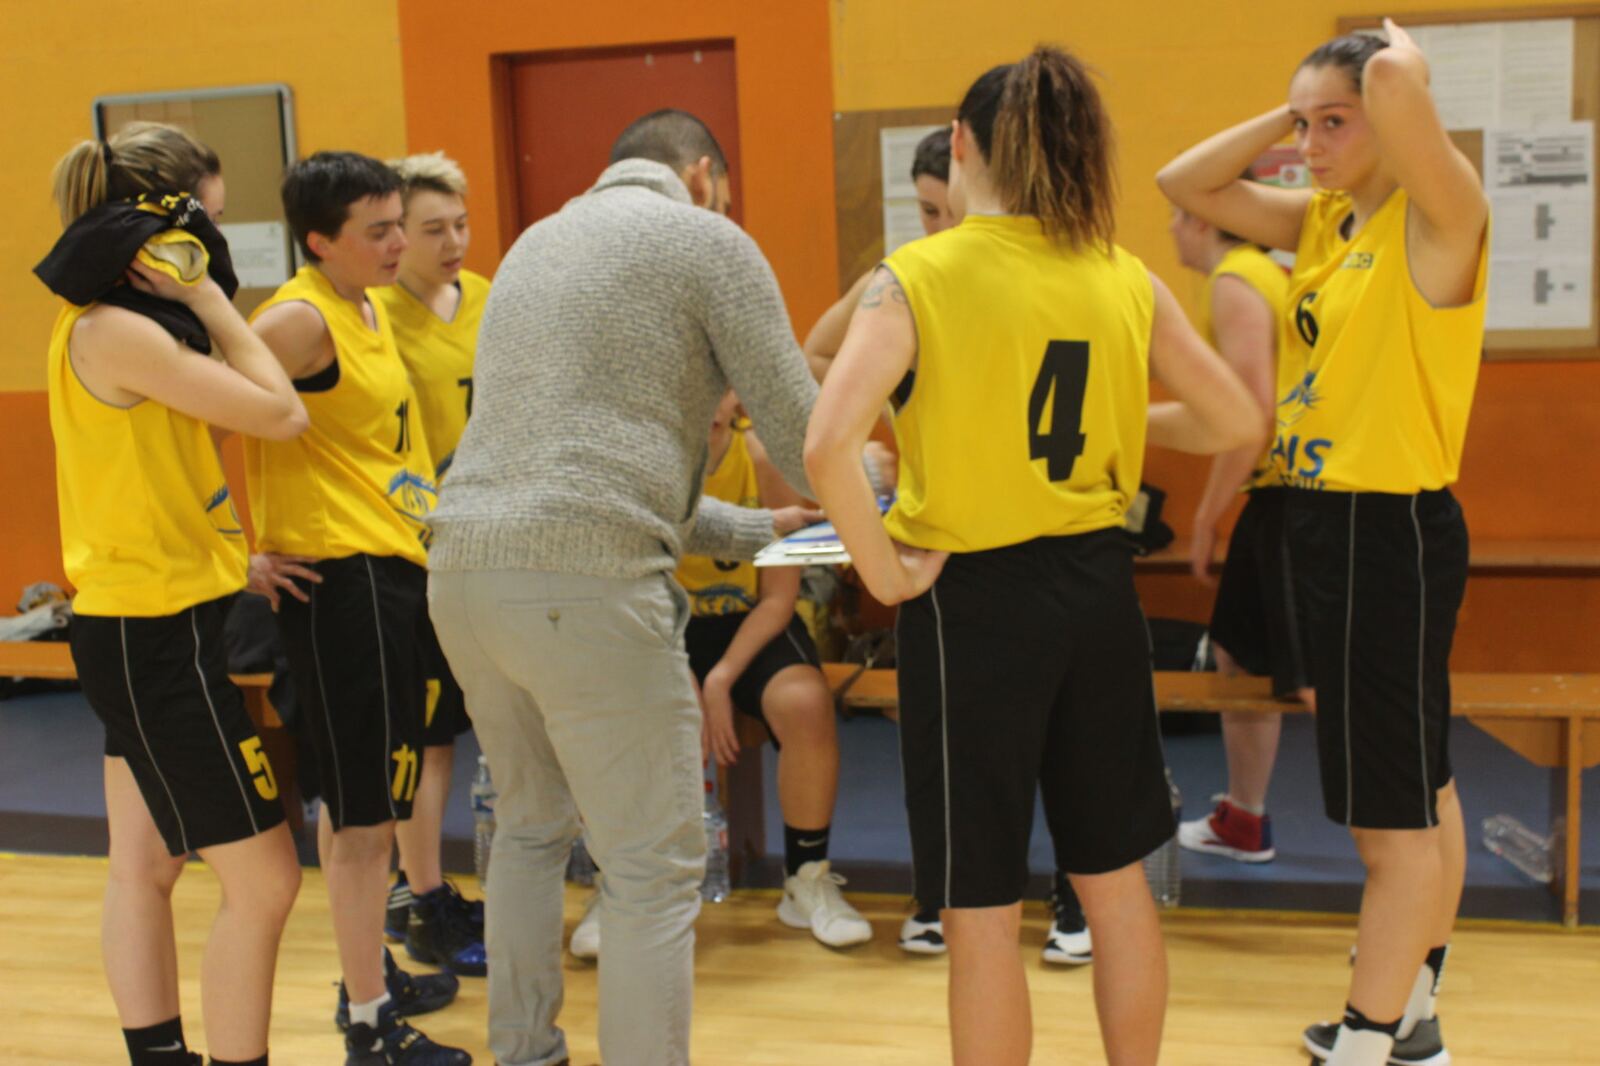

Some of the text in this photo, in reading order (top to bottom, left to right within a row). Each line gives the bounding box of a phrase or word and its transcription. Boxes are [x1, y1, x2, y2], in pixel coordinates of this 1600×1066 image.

[1296, 291, 1320, 349] 6
[1027, 338, 1090, 482] 4
[238, 735, 279, 801] 5
[391, 743, 418, 801] 11
